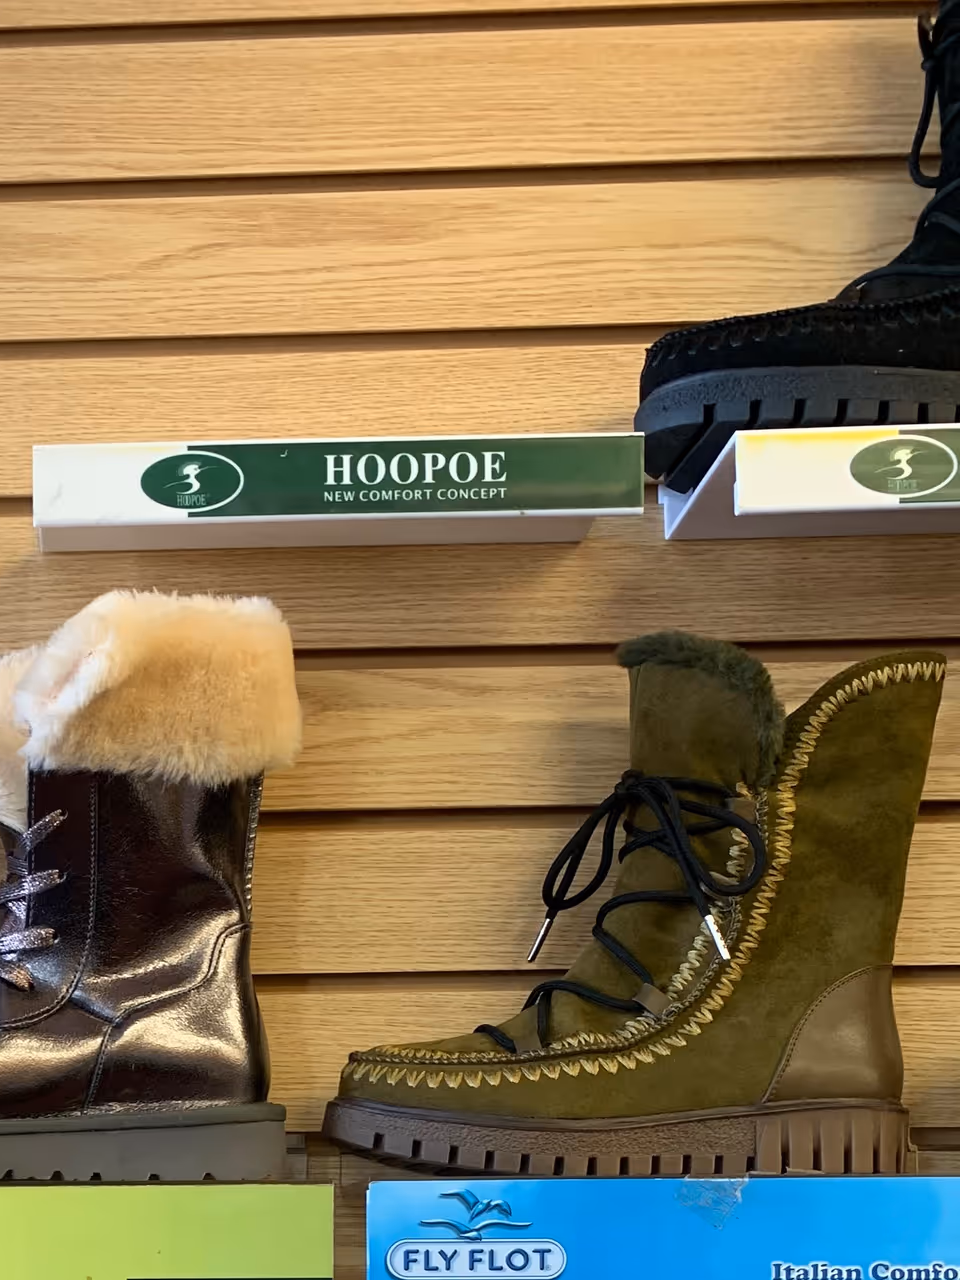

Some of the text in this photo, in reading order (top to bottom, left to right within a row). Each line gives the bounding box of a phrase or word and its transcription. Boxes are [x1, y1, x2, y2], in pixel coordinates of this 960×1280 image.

[323, 451, 507, 485] HOOPOE
[324, 487, 507, 502] NEW COMFORT CONCEPT
[403, 1248, 552, 1271] FLY FLOT
[772, 1262, 960, 1280] Italian Comfo
